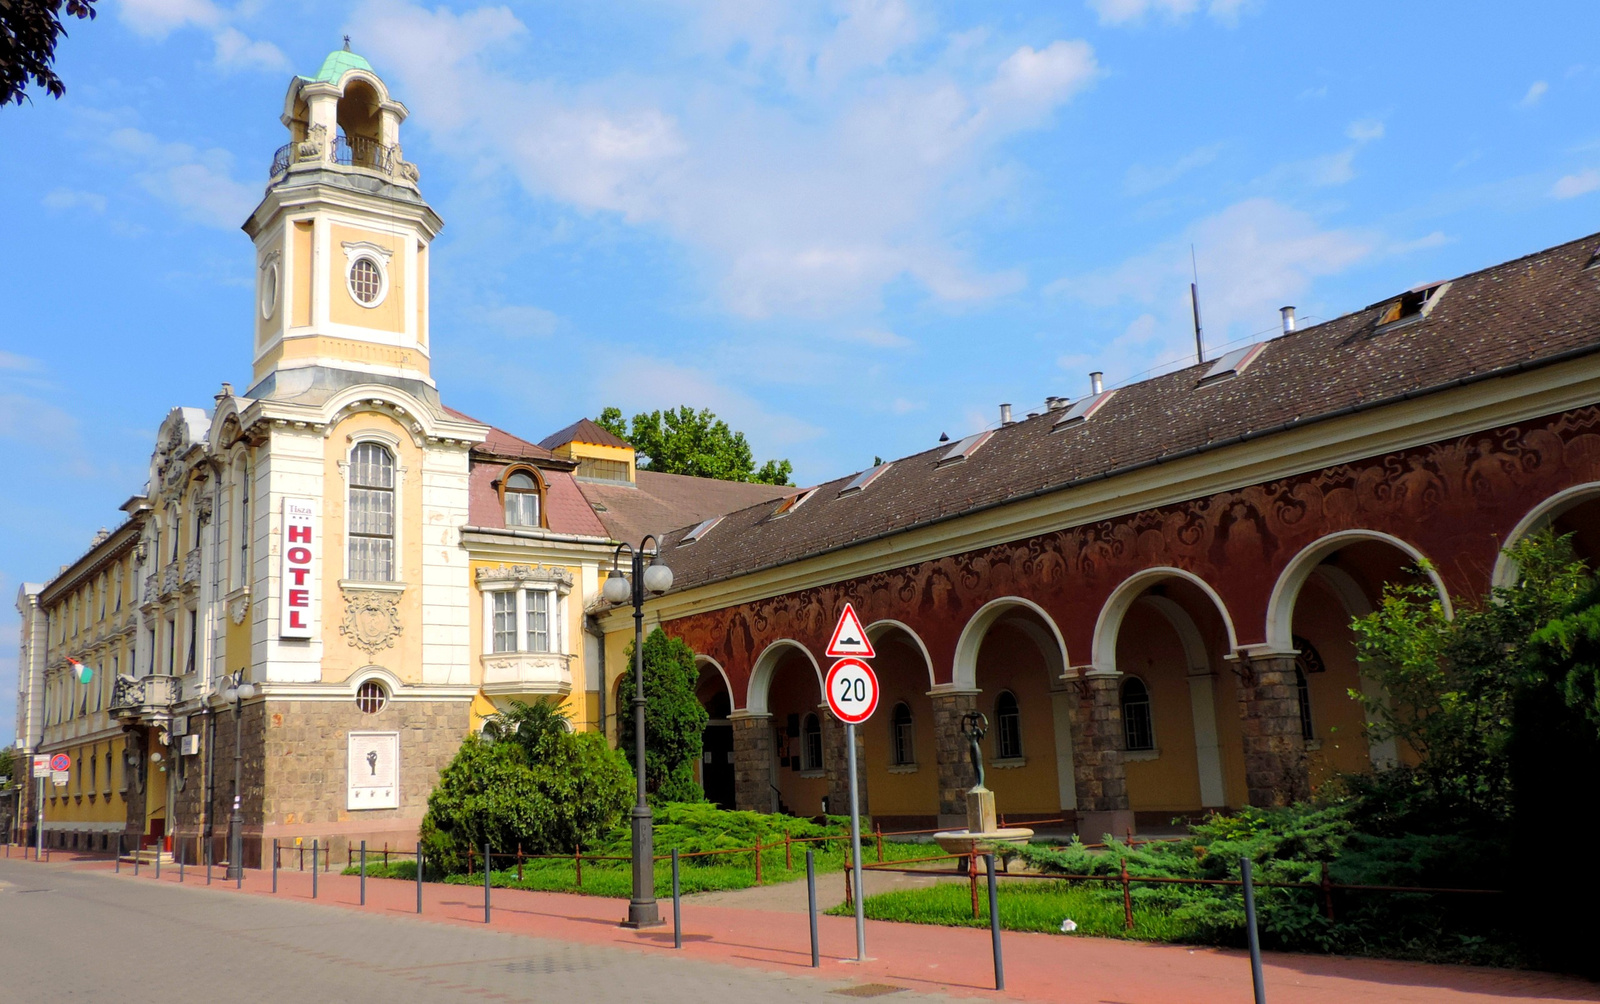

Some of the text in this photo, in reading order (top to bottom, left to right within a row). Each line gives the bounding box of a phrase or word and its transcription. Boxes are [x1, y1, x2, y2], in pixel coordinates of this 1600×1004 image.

[289, 505, 312, 514] Tisza
[287, 525, 312, 629] HOTEL
[840, 678, 866, 702] 20
